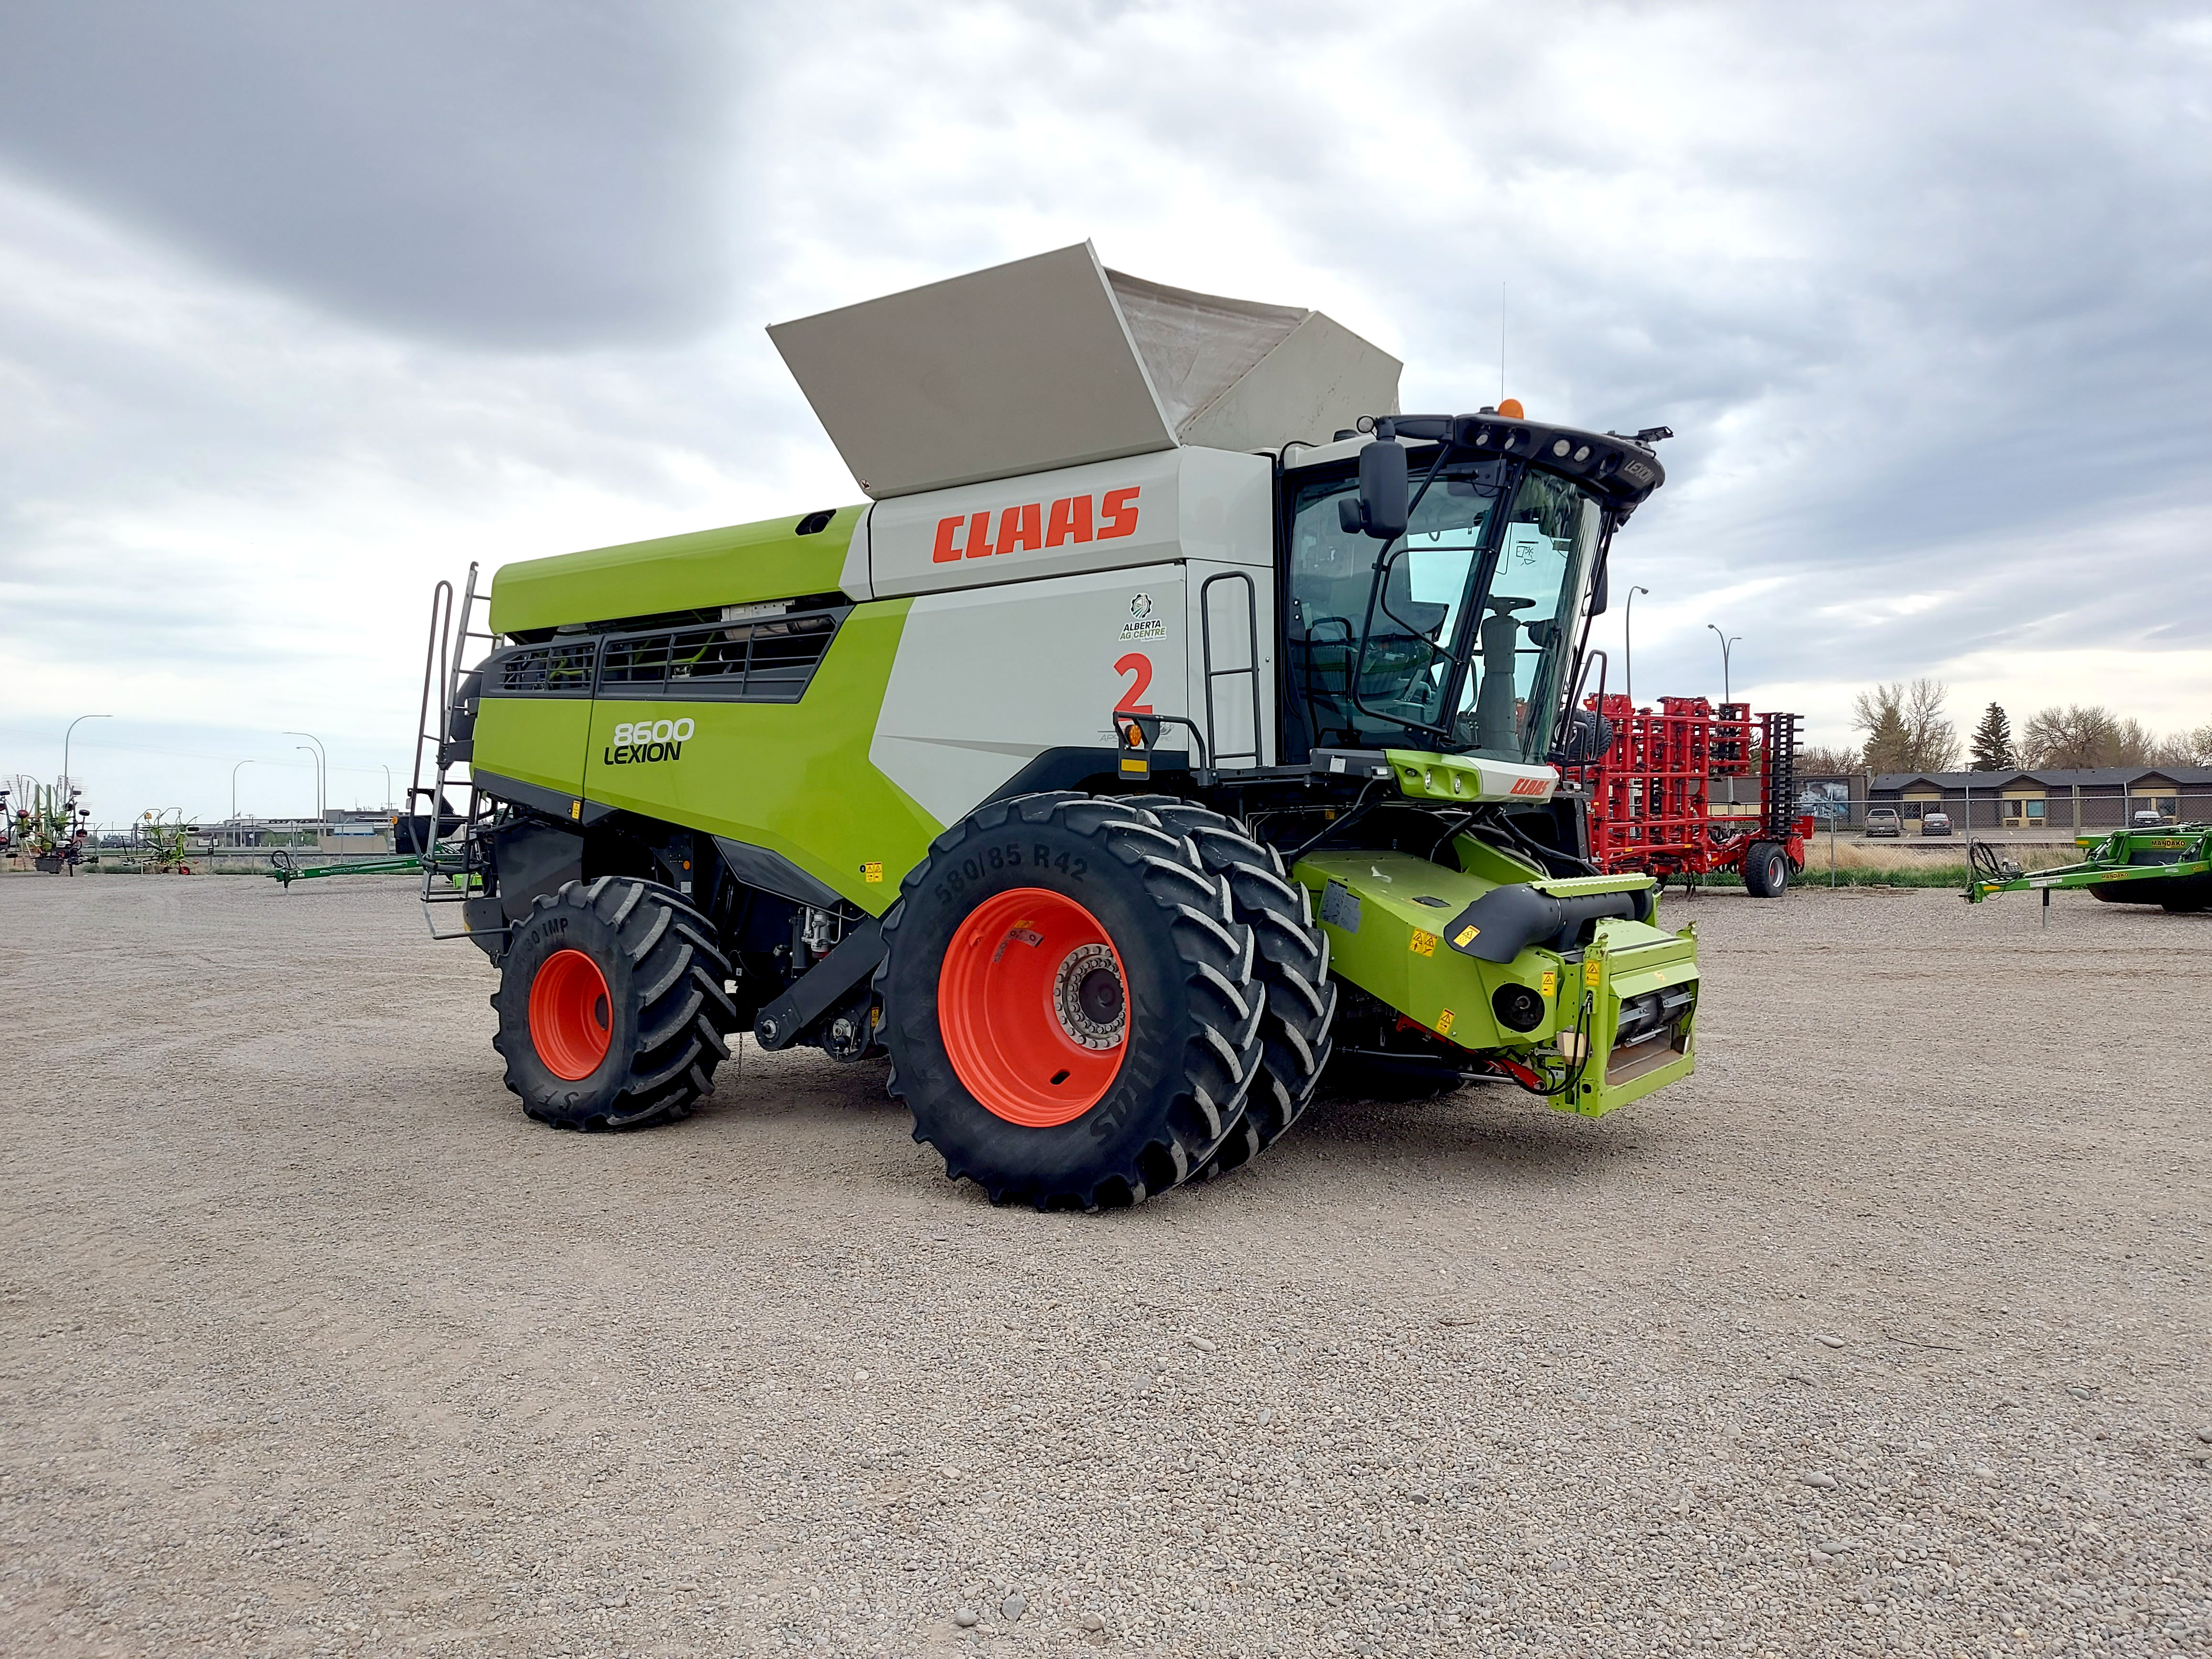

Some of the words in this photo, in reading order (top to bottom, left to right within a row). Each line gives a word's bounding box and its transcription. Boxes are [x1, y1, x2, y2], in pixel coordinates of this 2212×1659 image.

[1624, 459, 1655, 483] LEXION
[932, 486, 1141, 563] CLAAS
[1120, 632, 1131, 640] AG
[1133, 628, 1166, 638] CENTRE
[1123, 620, 1161, 631] ALBERTA
[1114, 653, 1153, 721] 2
[613, 718, 695, 746] 8600
[604, 741, 682, 765] LEXION
[1510, 778, 1550, 796] CLAAS
[934, 843, 1022, 905] 580/85
[1033, 843, 1088, 884] R42
[542, 918, 568, 937] IMP
